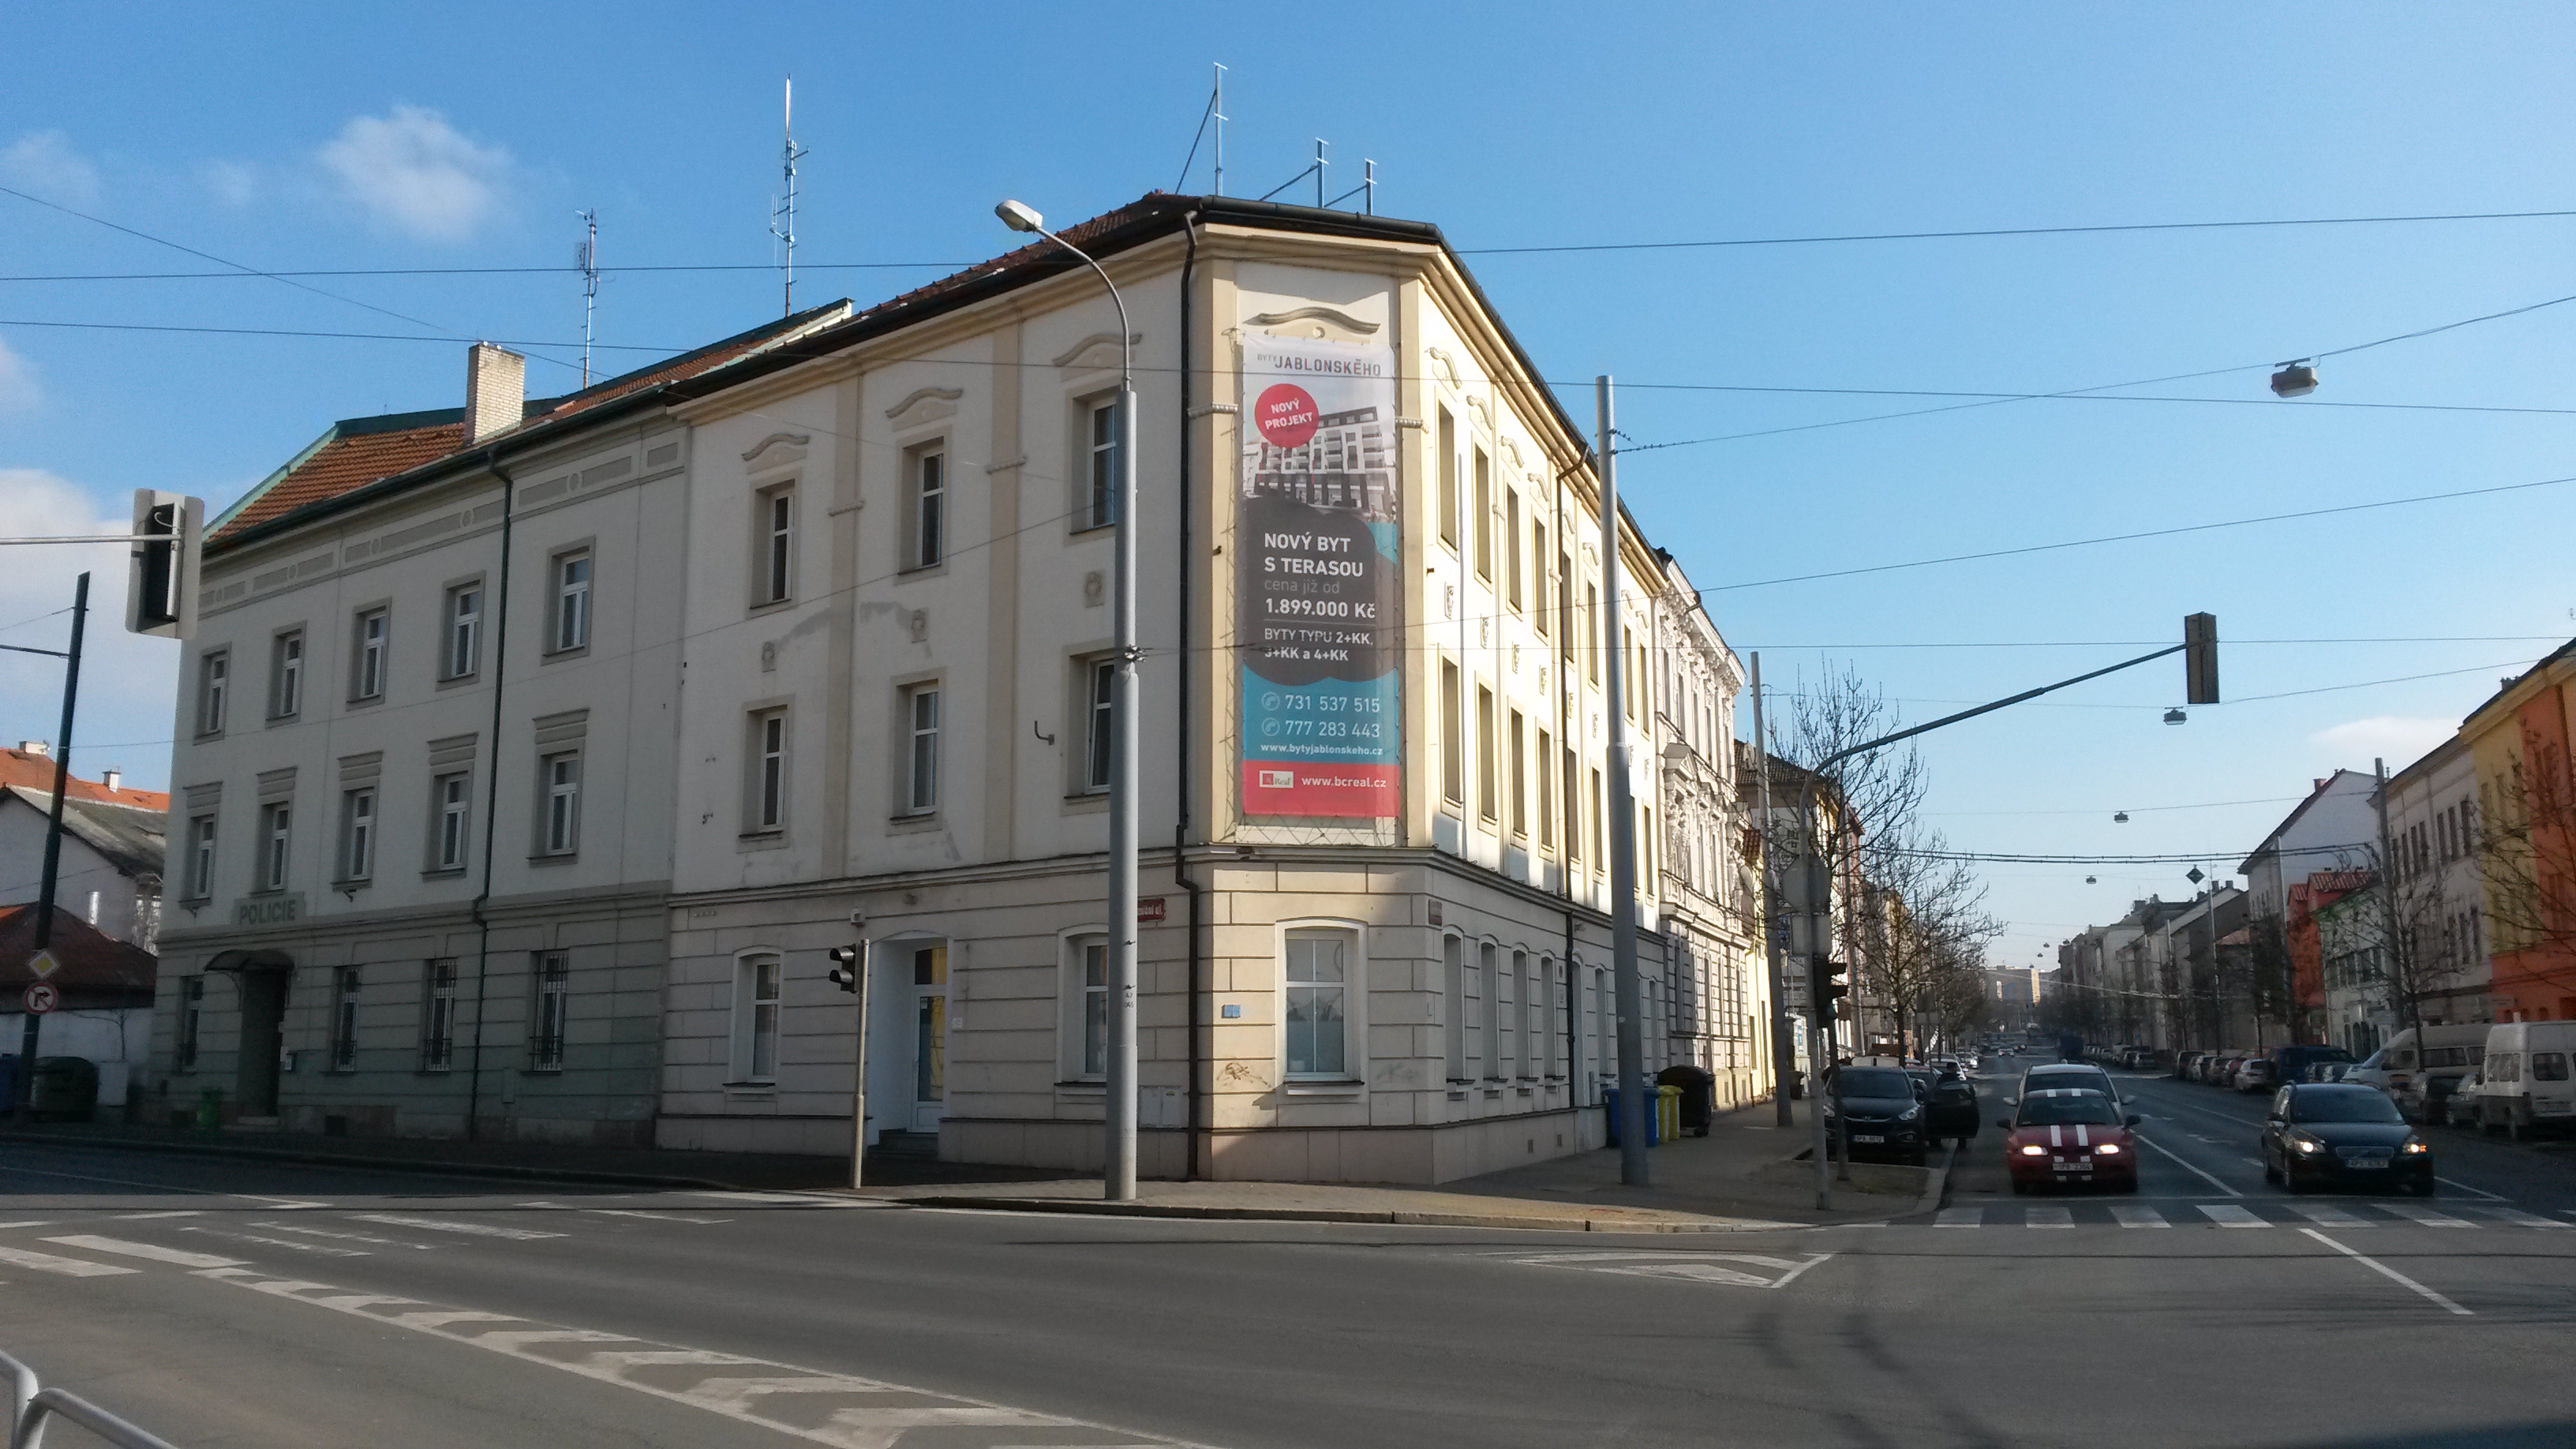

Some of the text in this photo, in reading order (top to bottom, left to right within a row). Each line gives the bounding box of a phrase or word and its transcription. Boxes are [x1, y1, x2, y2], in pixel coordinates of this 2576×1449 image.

[1275, 356, 1381, 376] JABLONSKÉHO
[1271, 397, 1300, 414] NOVÝ
[1264, 412, 1312, 430] PROJEKT
[1264, 531, 1351, 552] NOVÝ BYT
[1264, 557, 1363, 577] S TERASOU
[1264, 579, 1340, 595] cena již od
[1265, 598, 1376, 619] 1.899.000 Kč
[1264, 628, 1374, 646] BYTY TYPU 2+KK,
[1303, 650, 1310, 660] a
[1313, 648, 1349, 661] 4+KK
[1285, 695, 1380, 713] 731 537 515
[1285, 720, 1380, 738] 777 283 443
[1260, 743, 1383, 756] www.bytyjablonskeho.cz
[1301, 776, 1387, 788] www.bcreal.cz
[238, 900, 296, 925] POLICIE
